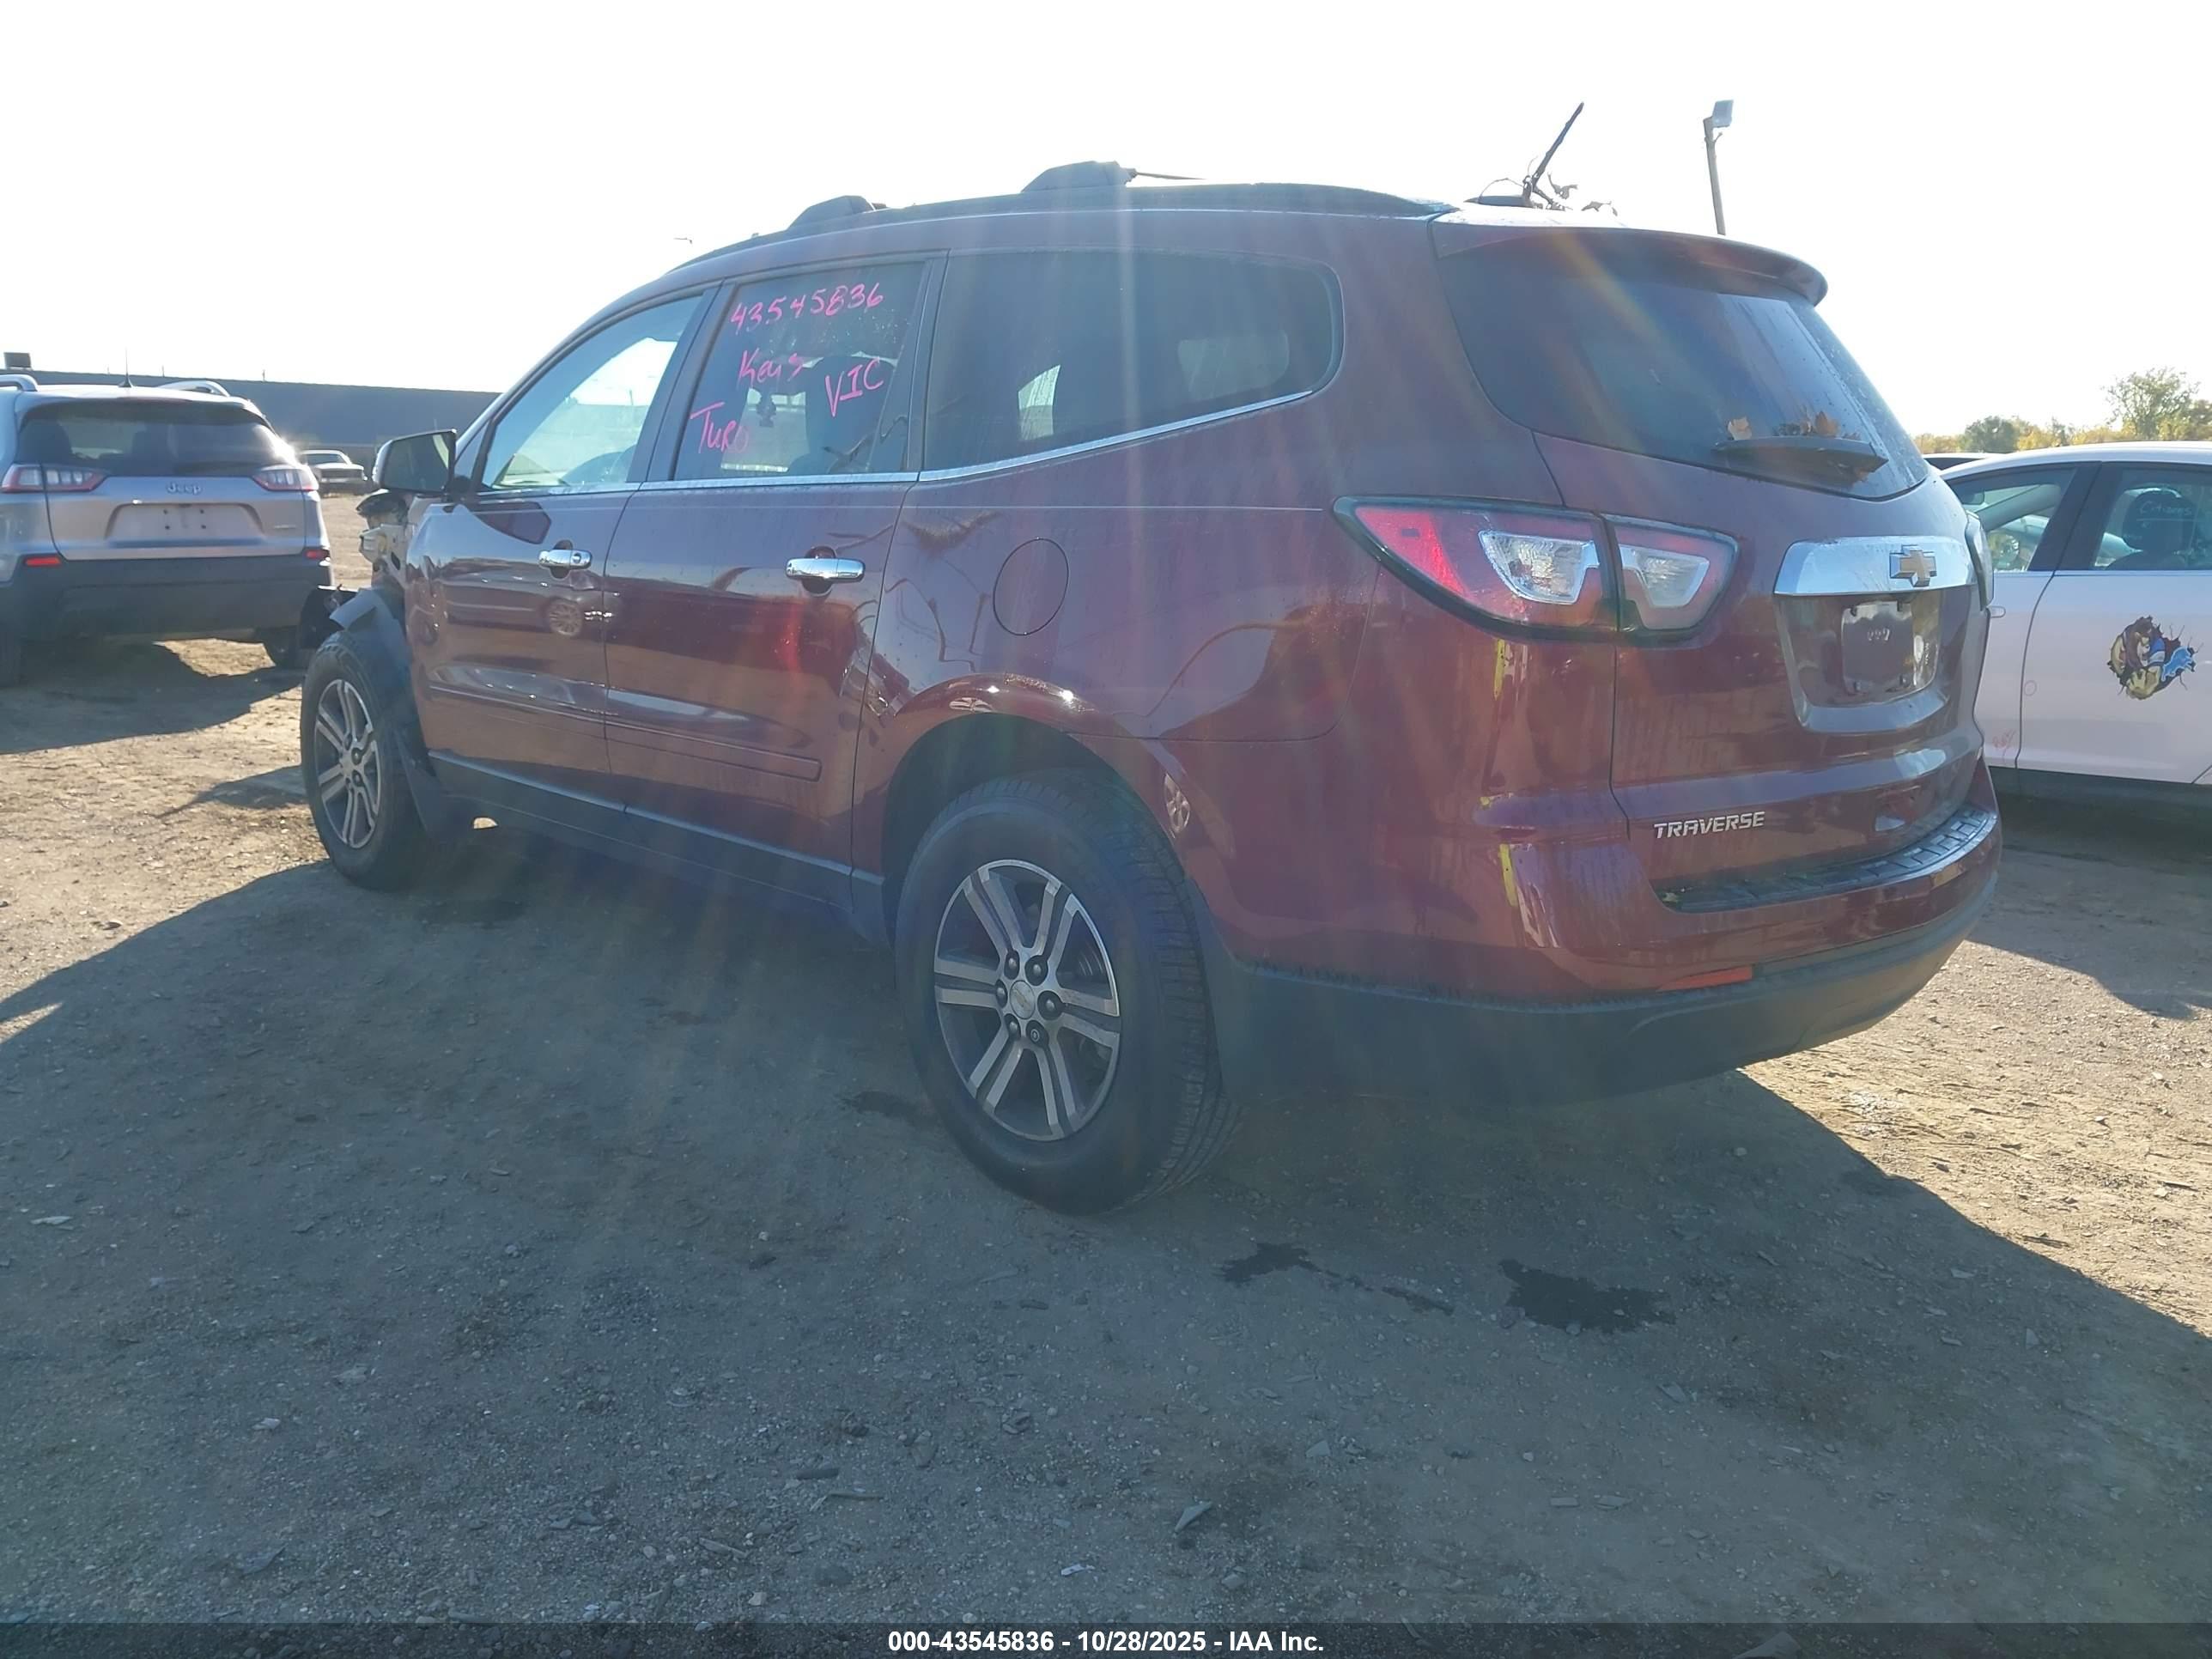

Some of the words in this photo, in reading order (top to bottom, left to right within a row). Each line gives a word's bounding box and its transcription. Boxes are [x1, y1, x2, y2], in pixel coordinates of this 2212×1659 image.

[731, 283, 884, 335] 43545836
[824, 354, 884, 417] VIC
[1654, 811, 1765, 839] TRAVERSE
